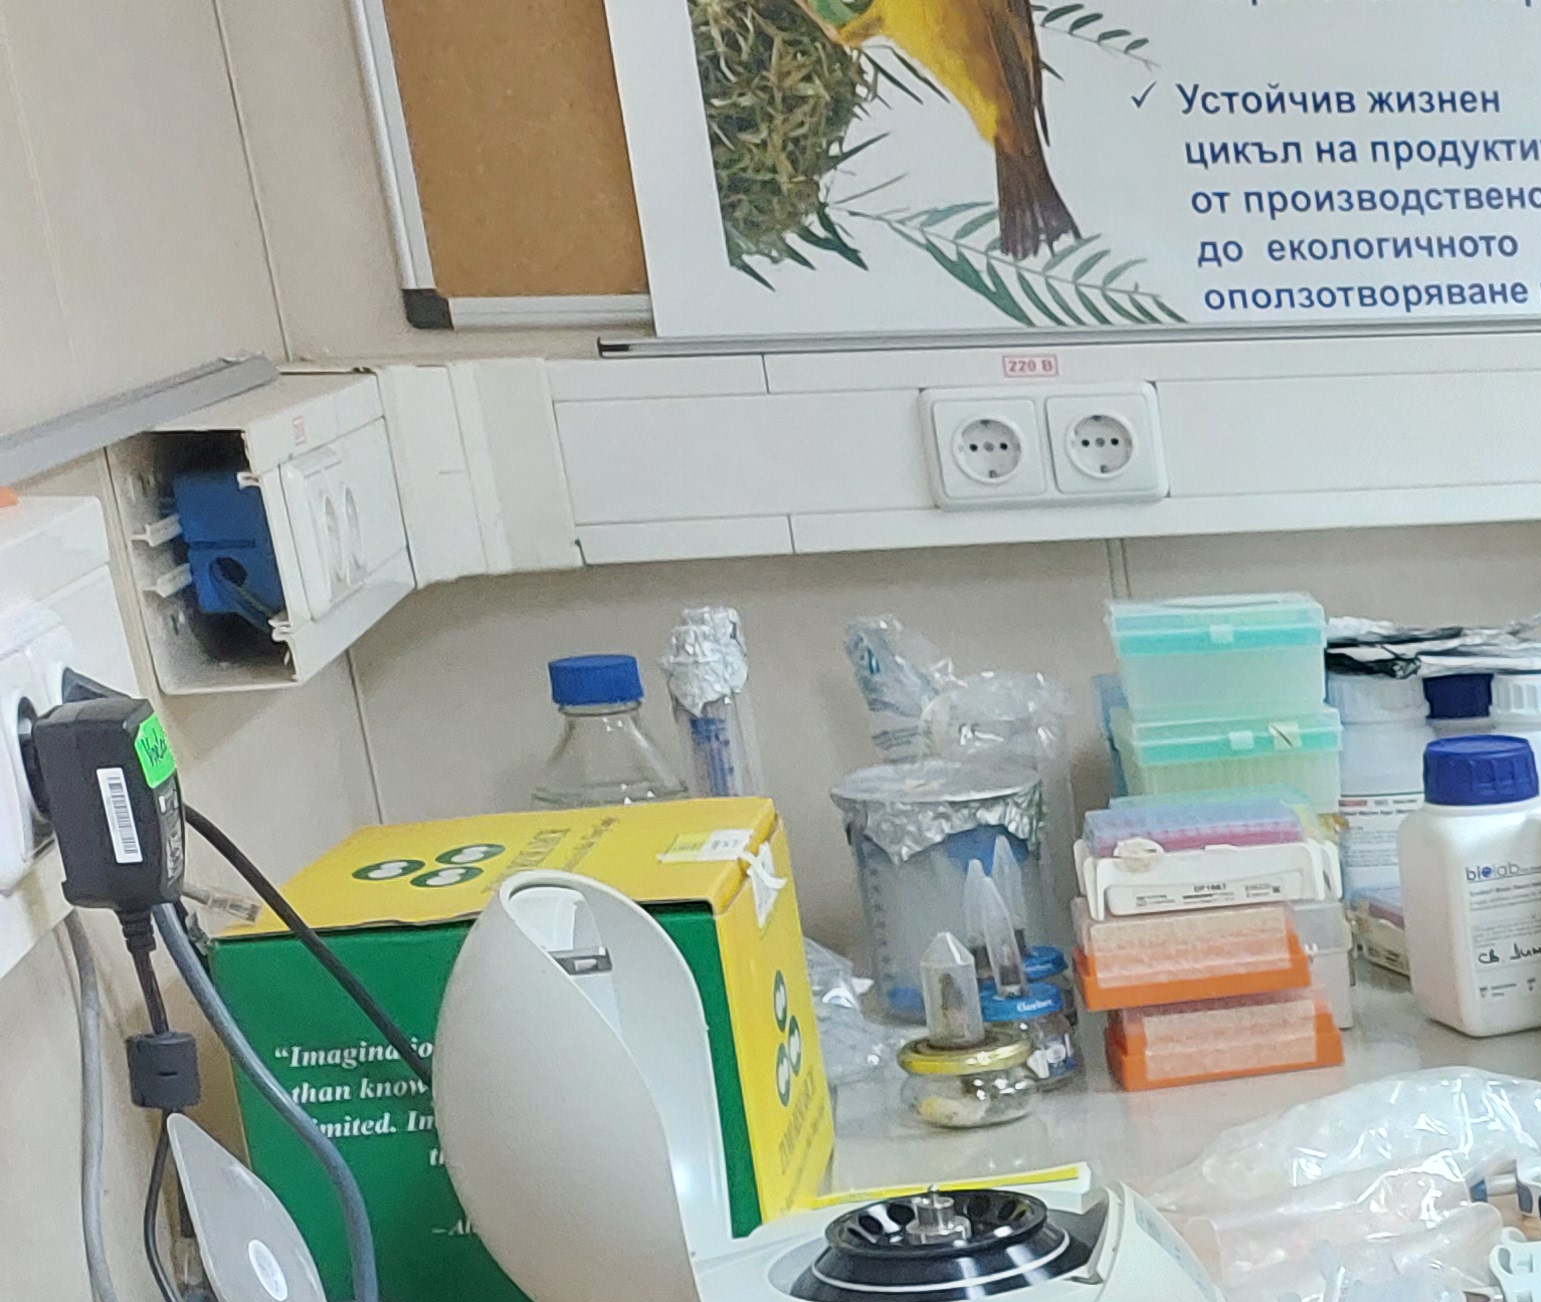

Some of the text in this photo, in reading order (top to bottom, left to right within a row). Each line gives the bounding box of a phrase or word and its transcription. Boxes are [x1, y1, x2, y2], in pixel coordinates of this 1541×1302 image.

[1176, 82, 1500, 115] Устойчив жизнен
[1184, 138, 1303, 170] цикъл
[1315, 142, 1358, 164] на
[1191, 189, 1230, 215] от
[1198, 232, 1519, 268] до екологичното
[1204, 279, 1529, 312] оползотворяване
[1008, 359, 1036, 372] 220
[291, 1082, 351, 1104] than
[313, 1111, 397, 1139] imited.
